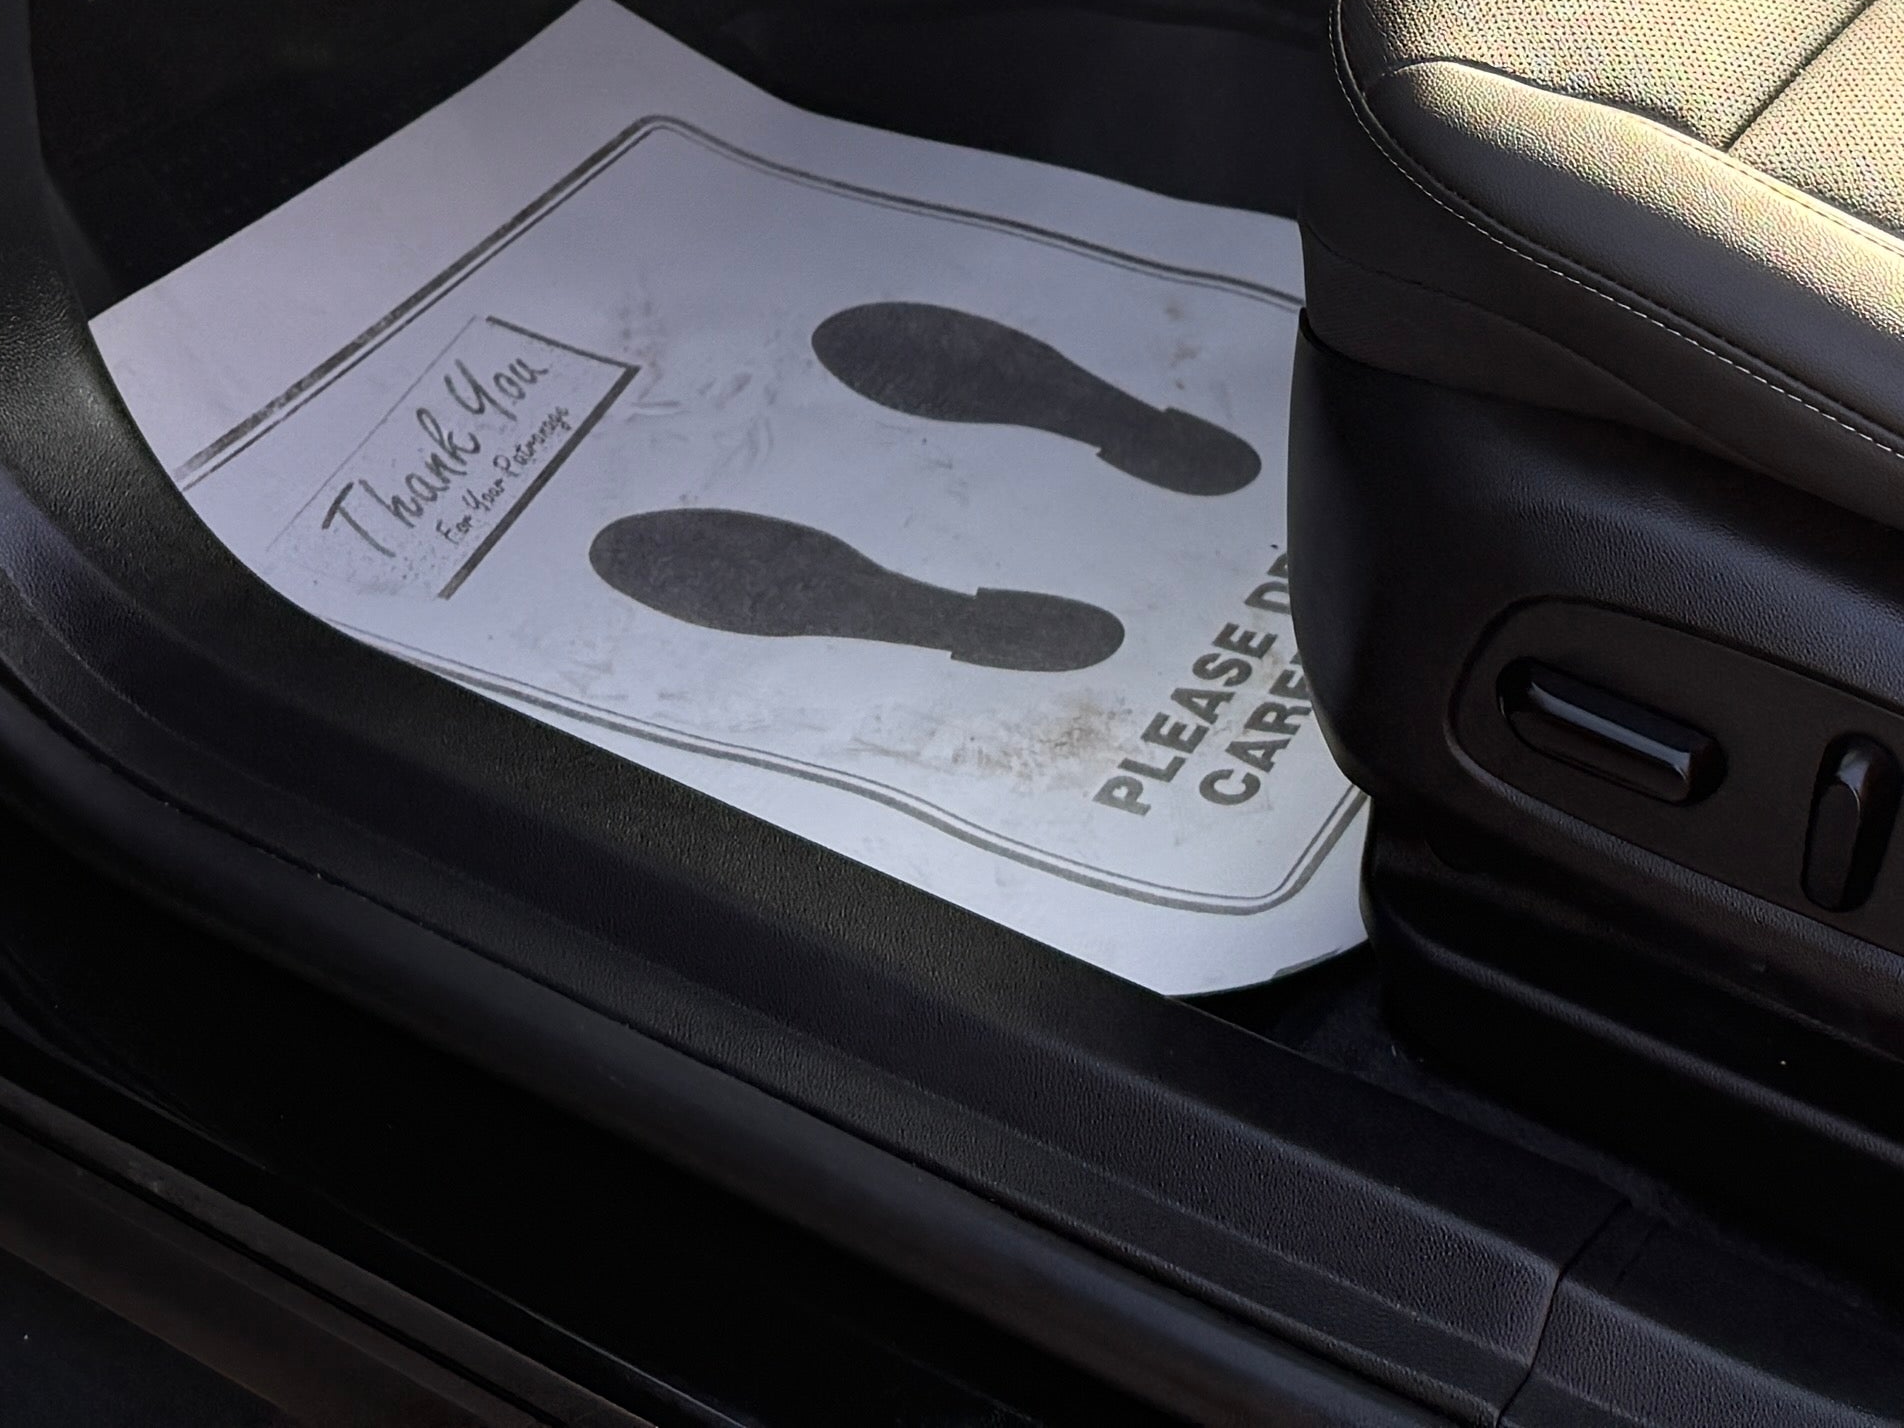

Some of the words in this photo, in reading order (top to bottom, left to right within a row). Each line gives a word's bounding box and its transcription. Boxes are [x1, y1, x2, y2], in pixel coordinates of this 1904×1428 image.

[321, 406, 482, 559] Thank
[444, 357, 549, 423] You
[435, 514, 473, 545] For
[461, 478, 506, 512] Your
[1092, 621, 1279, 817] PLEASE
[1198, 651, 1313, 806] CARE
